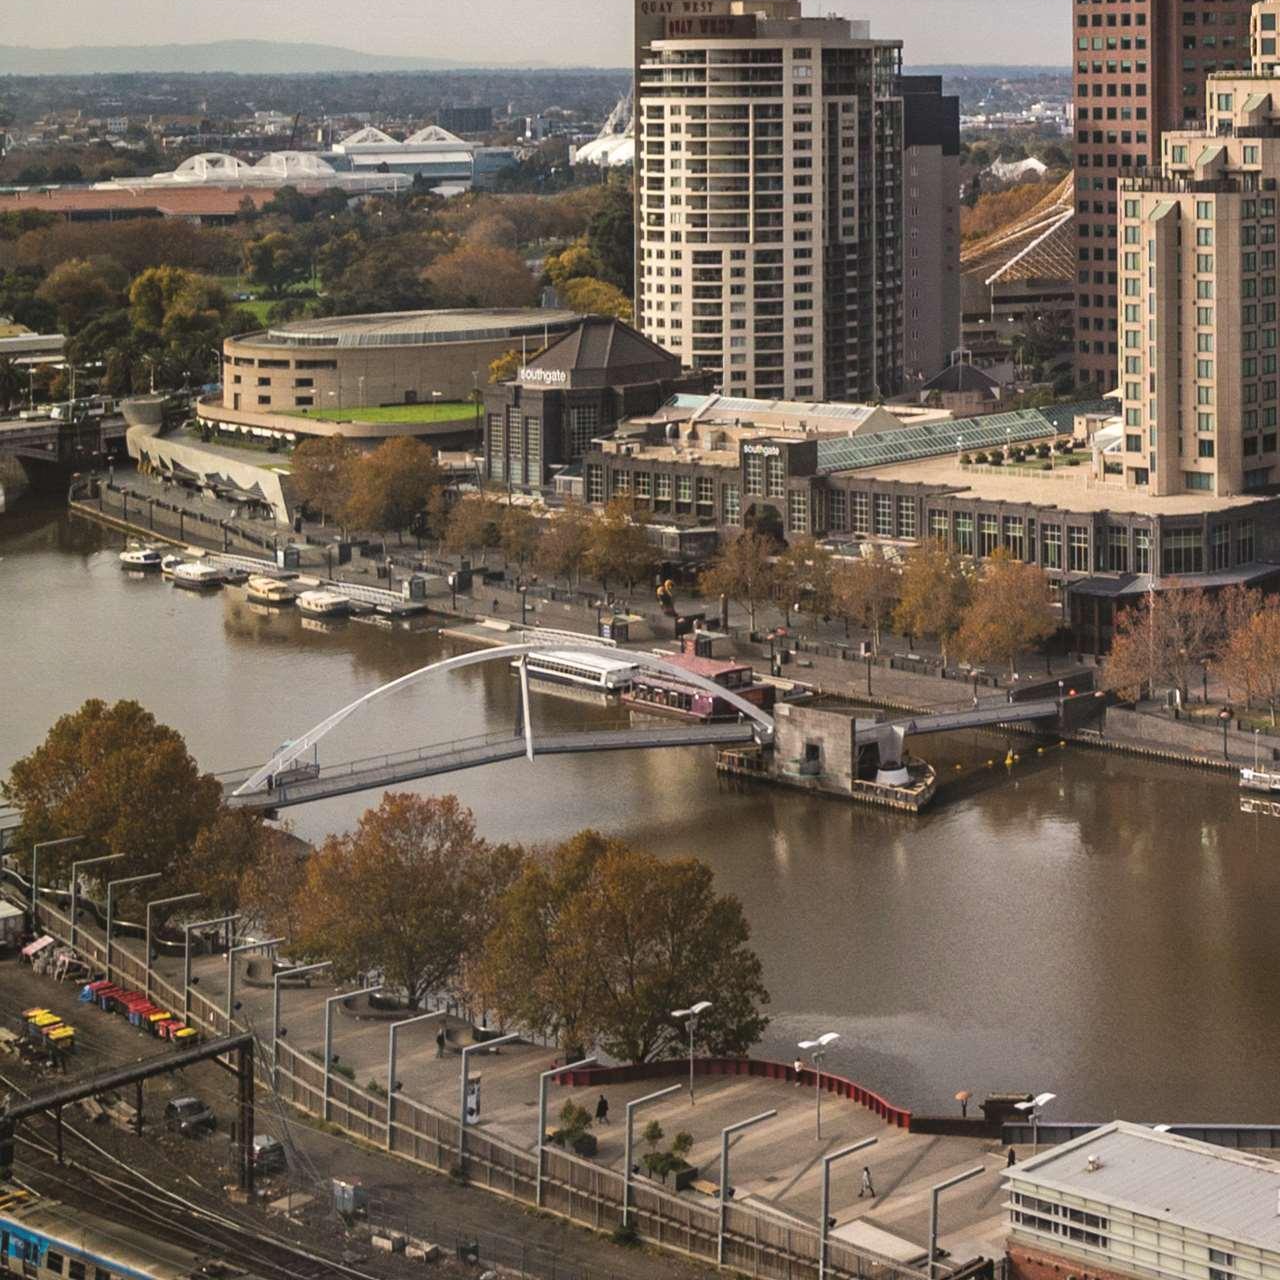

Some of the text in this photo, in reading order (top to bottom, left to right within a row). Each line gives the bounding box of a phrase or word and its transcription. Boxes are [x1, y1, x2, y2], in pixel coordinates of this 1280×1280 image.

[641, 1, 714, 15] QUAY WEST
[669, 19, 693, 37] QUAY
[520, 368, 567, 384] southgate
[743, 444, 780, 457] southgate
